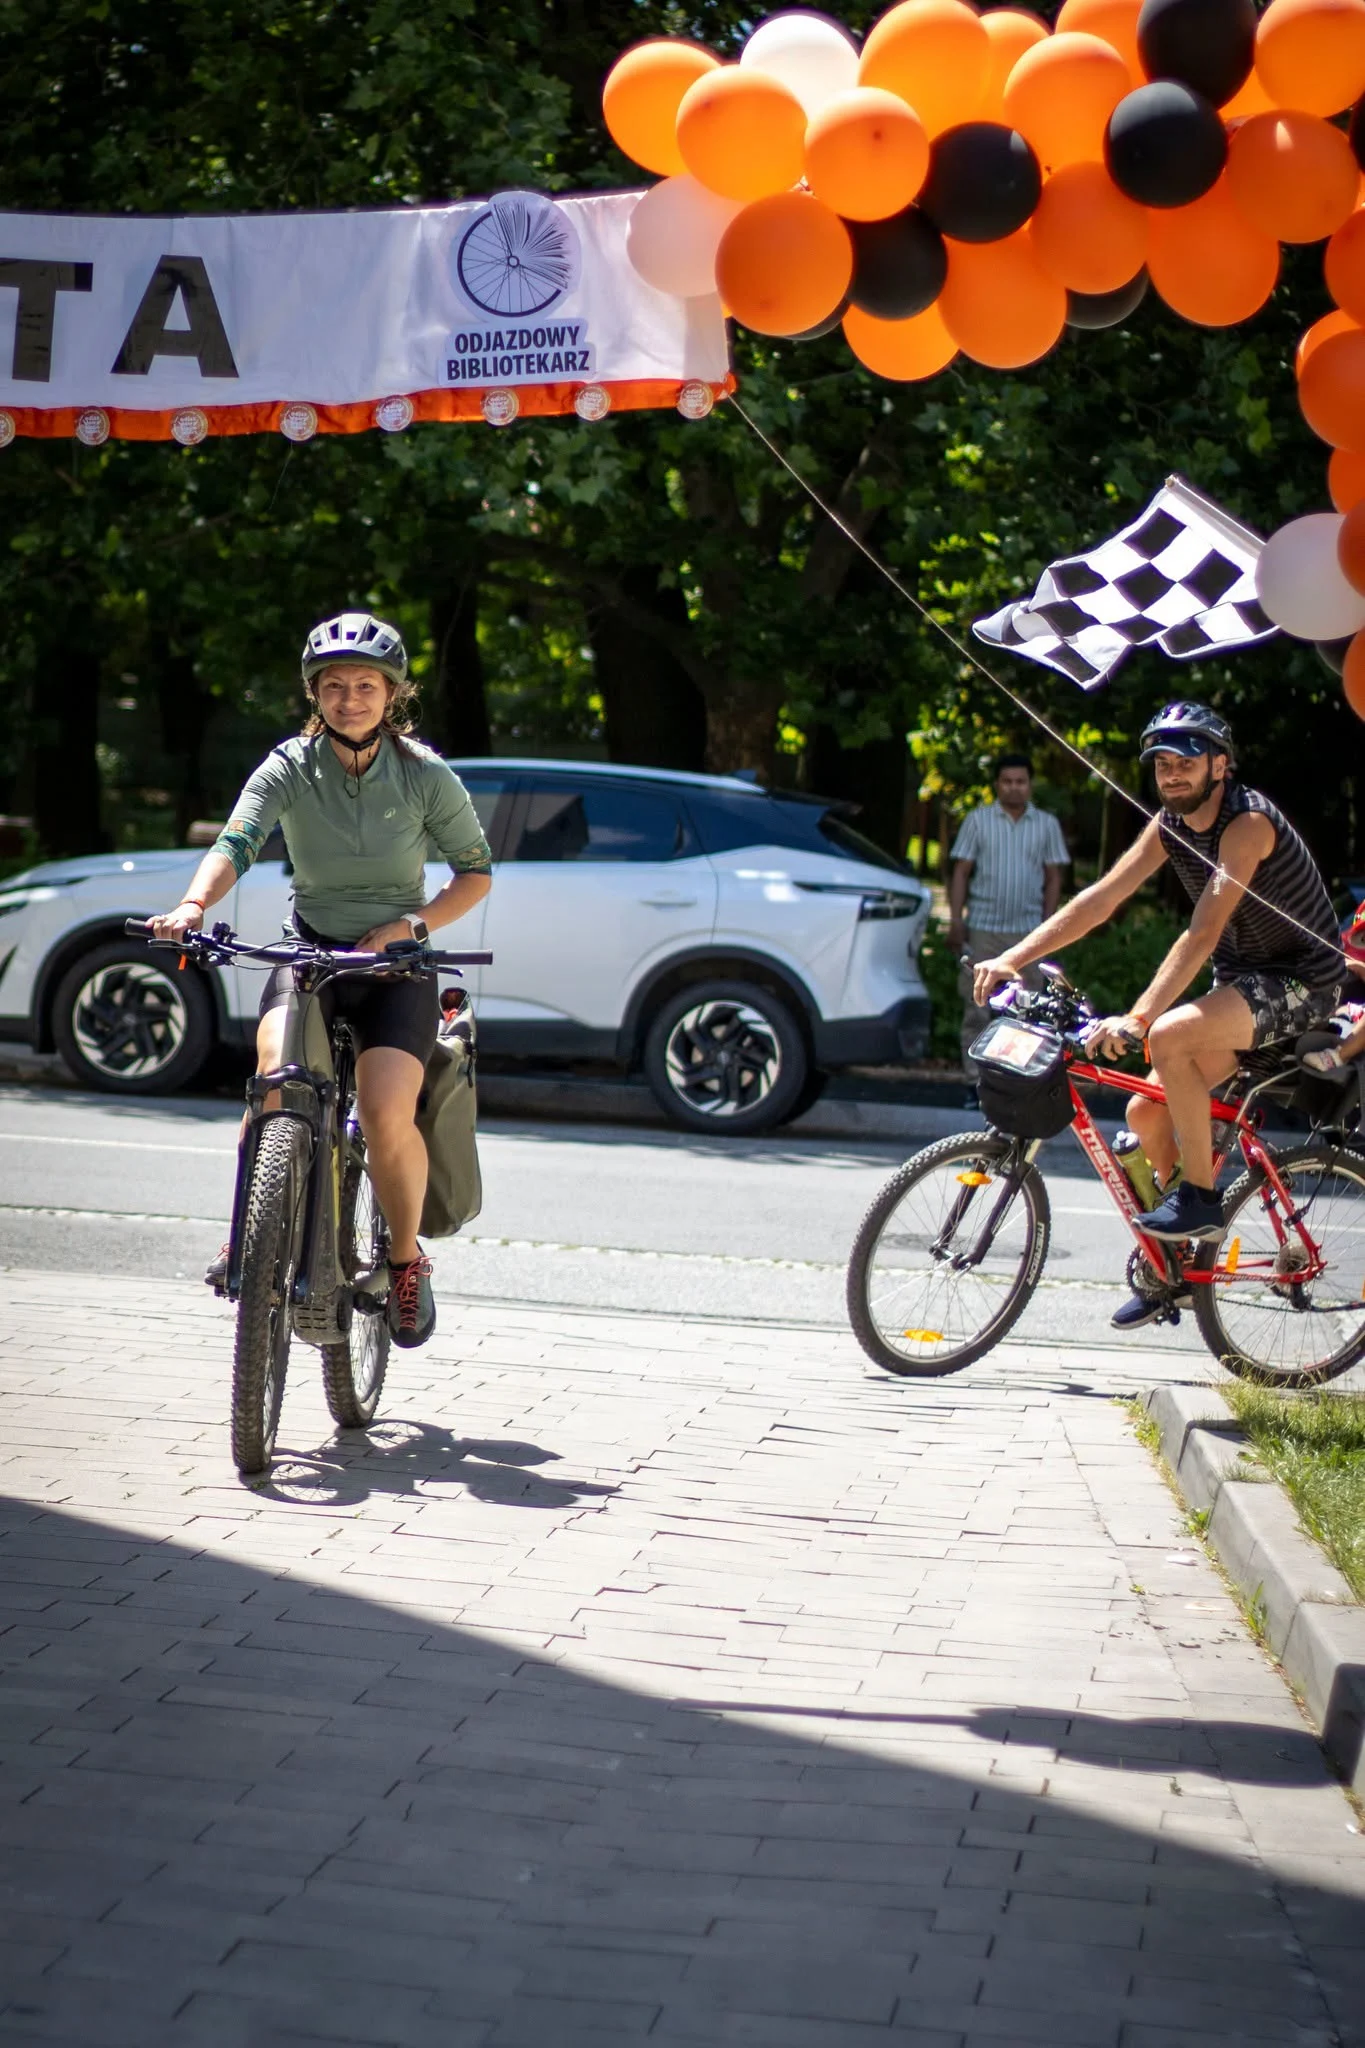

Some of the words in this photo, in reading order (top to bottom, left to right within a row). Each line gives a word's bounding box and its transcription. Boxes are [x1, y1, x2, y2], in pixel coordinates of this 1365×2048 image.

[454, 325, 580, 354] ODJAZDOWY
[446, 350, 590, 381] BIBLIOTEKARZ
[1027, 1221, 1045, 1286] MERIDA
